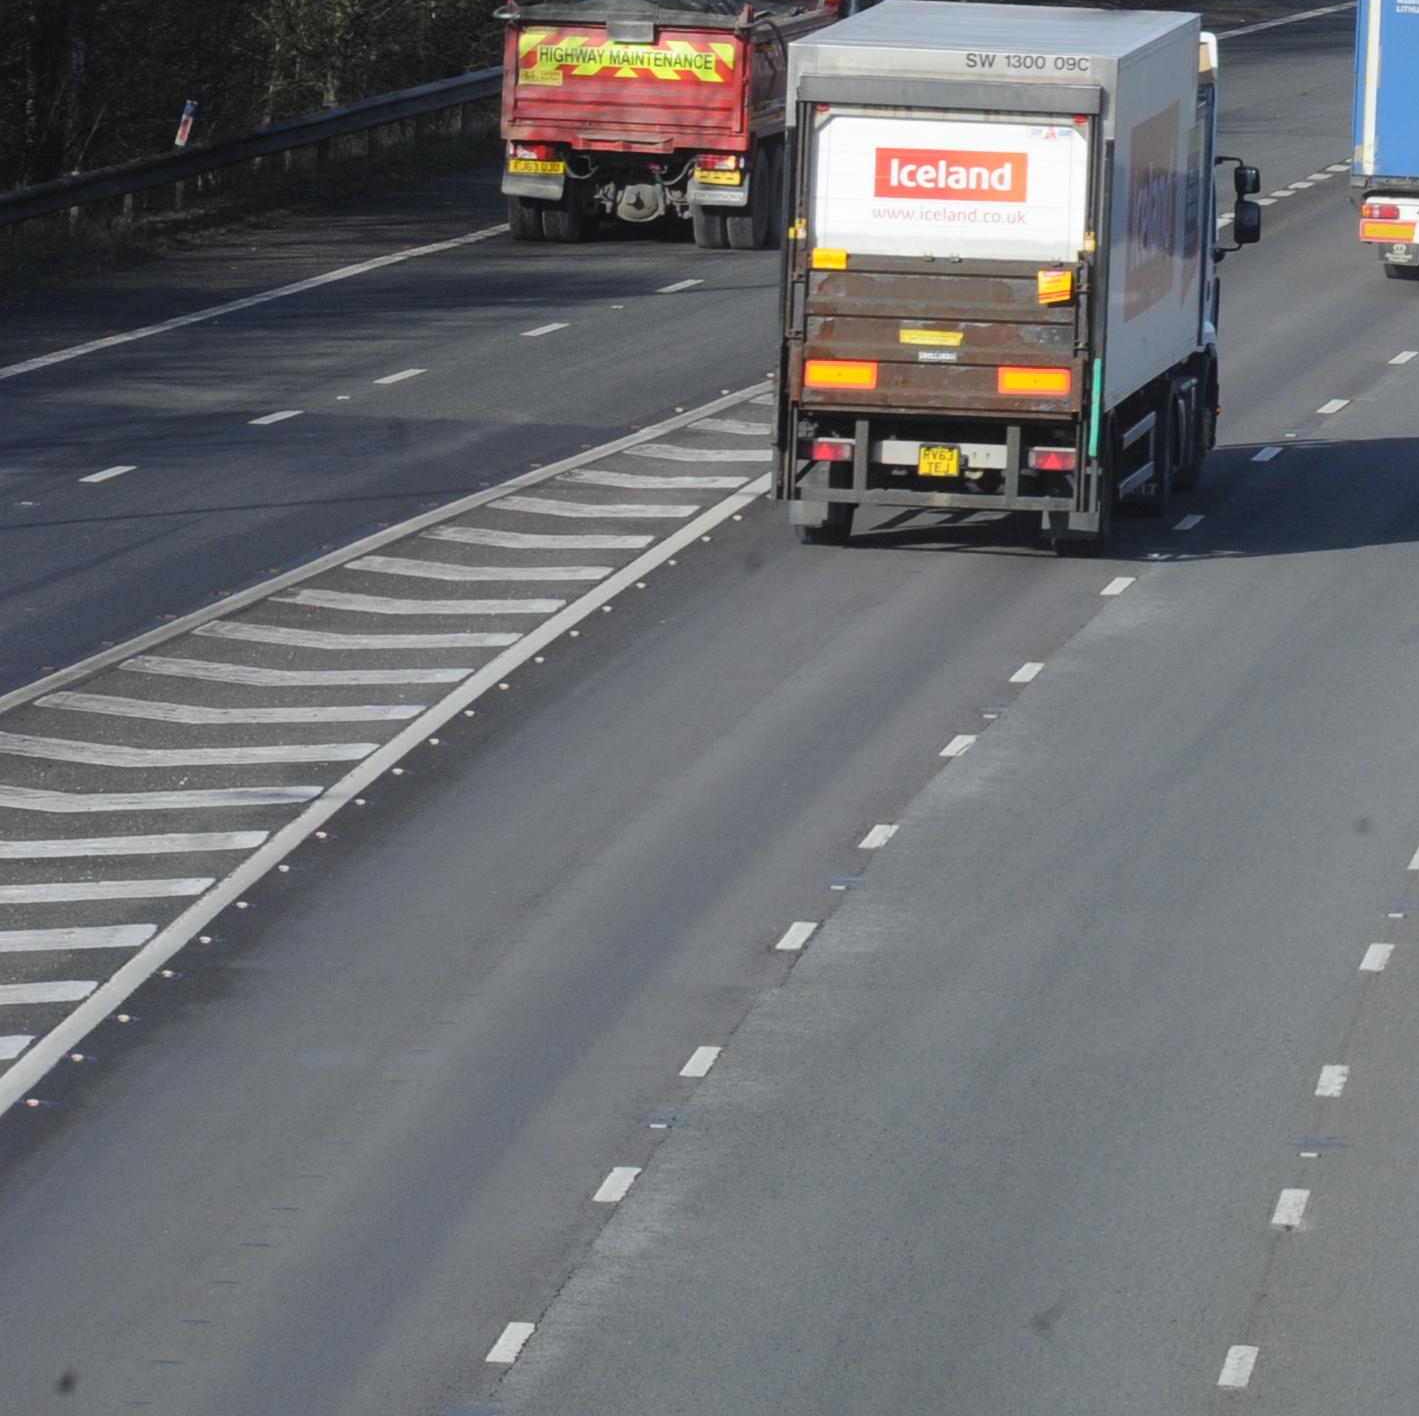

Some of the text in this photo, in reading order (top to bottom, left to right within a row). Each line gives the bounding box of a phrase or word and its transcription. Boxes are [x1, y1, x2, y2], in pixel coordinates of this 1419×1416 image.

[539, 46, 713, 70] HIGHWAY MAINTENANCE
[965, 53, 1090, 72] SW 1300 09C
[890, 158, 1013, 191] Iceland
[872, 206, 1027, 224] www.iceland.co.uk
[922, 449, 955, 474] RV63 TEJ
